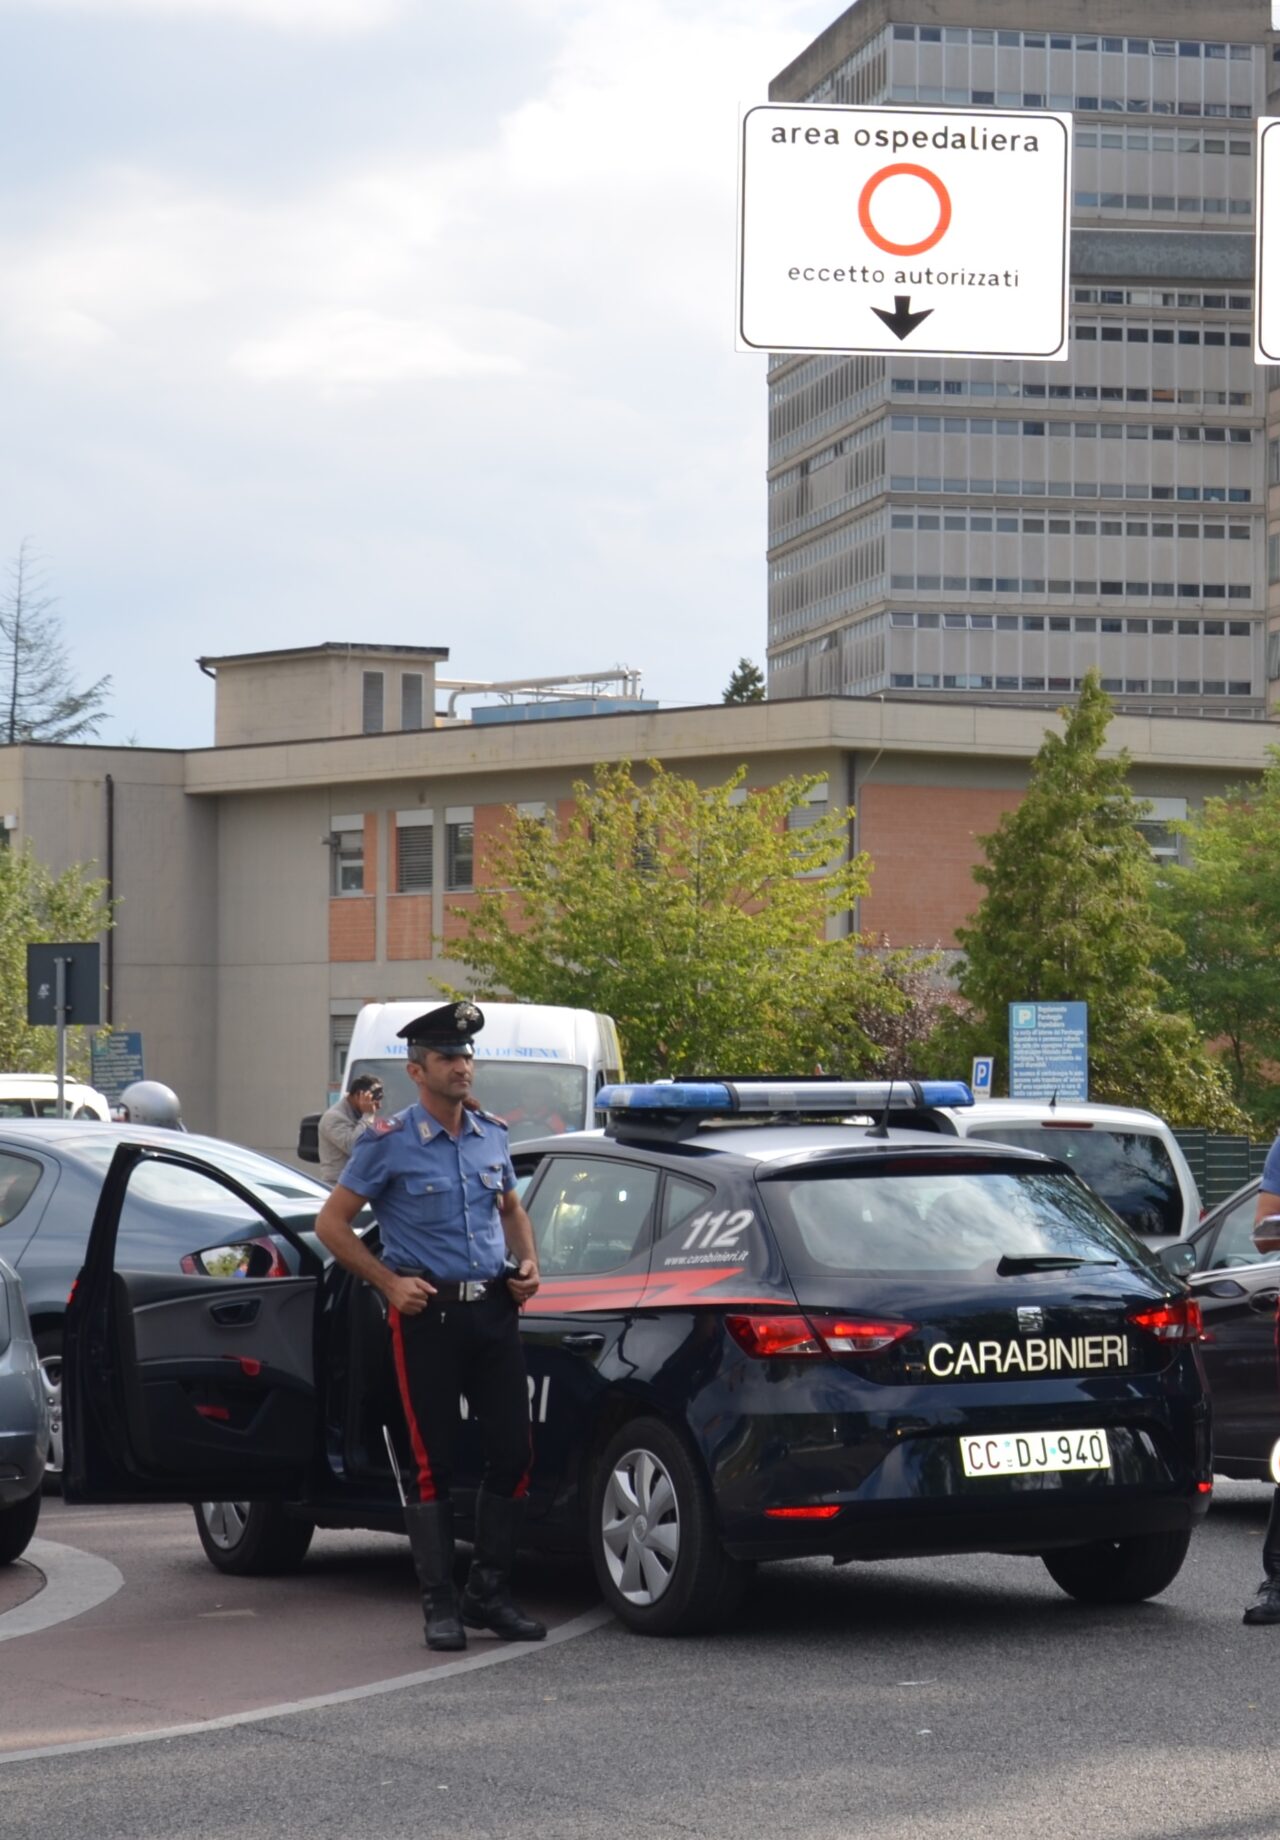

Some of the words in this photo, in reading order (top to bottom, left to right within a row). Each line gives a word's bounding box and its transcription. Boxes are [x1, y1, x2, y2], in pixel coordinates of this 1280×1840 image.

[771, 126, 840, 145] area
[854, 126, 1040, 153] ospedaliera
[788, 265, 885, 283] eccetto
[894, 267, 1020, 287] autorizzati
[1019, 1009, 1032, 1025] P
[515, 1047, 560, 1059] SIENA
[977, 1064, 988, 1085] P
[681, 1209, 754, 1250] 112
[664, 1250, 749, 1266] www.carabinieri.it
[929, 1334, 1128, 1377] CARABINIERI
[968, 1441, 1000, 1470] CC
[1016, 1437, 1048, 1467] DJ
[1058, 1435, 1104, 1464] 940
